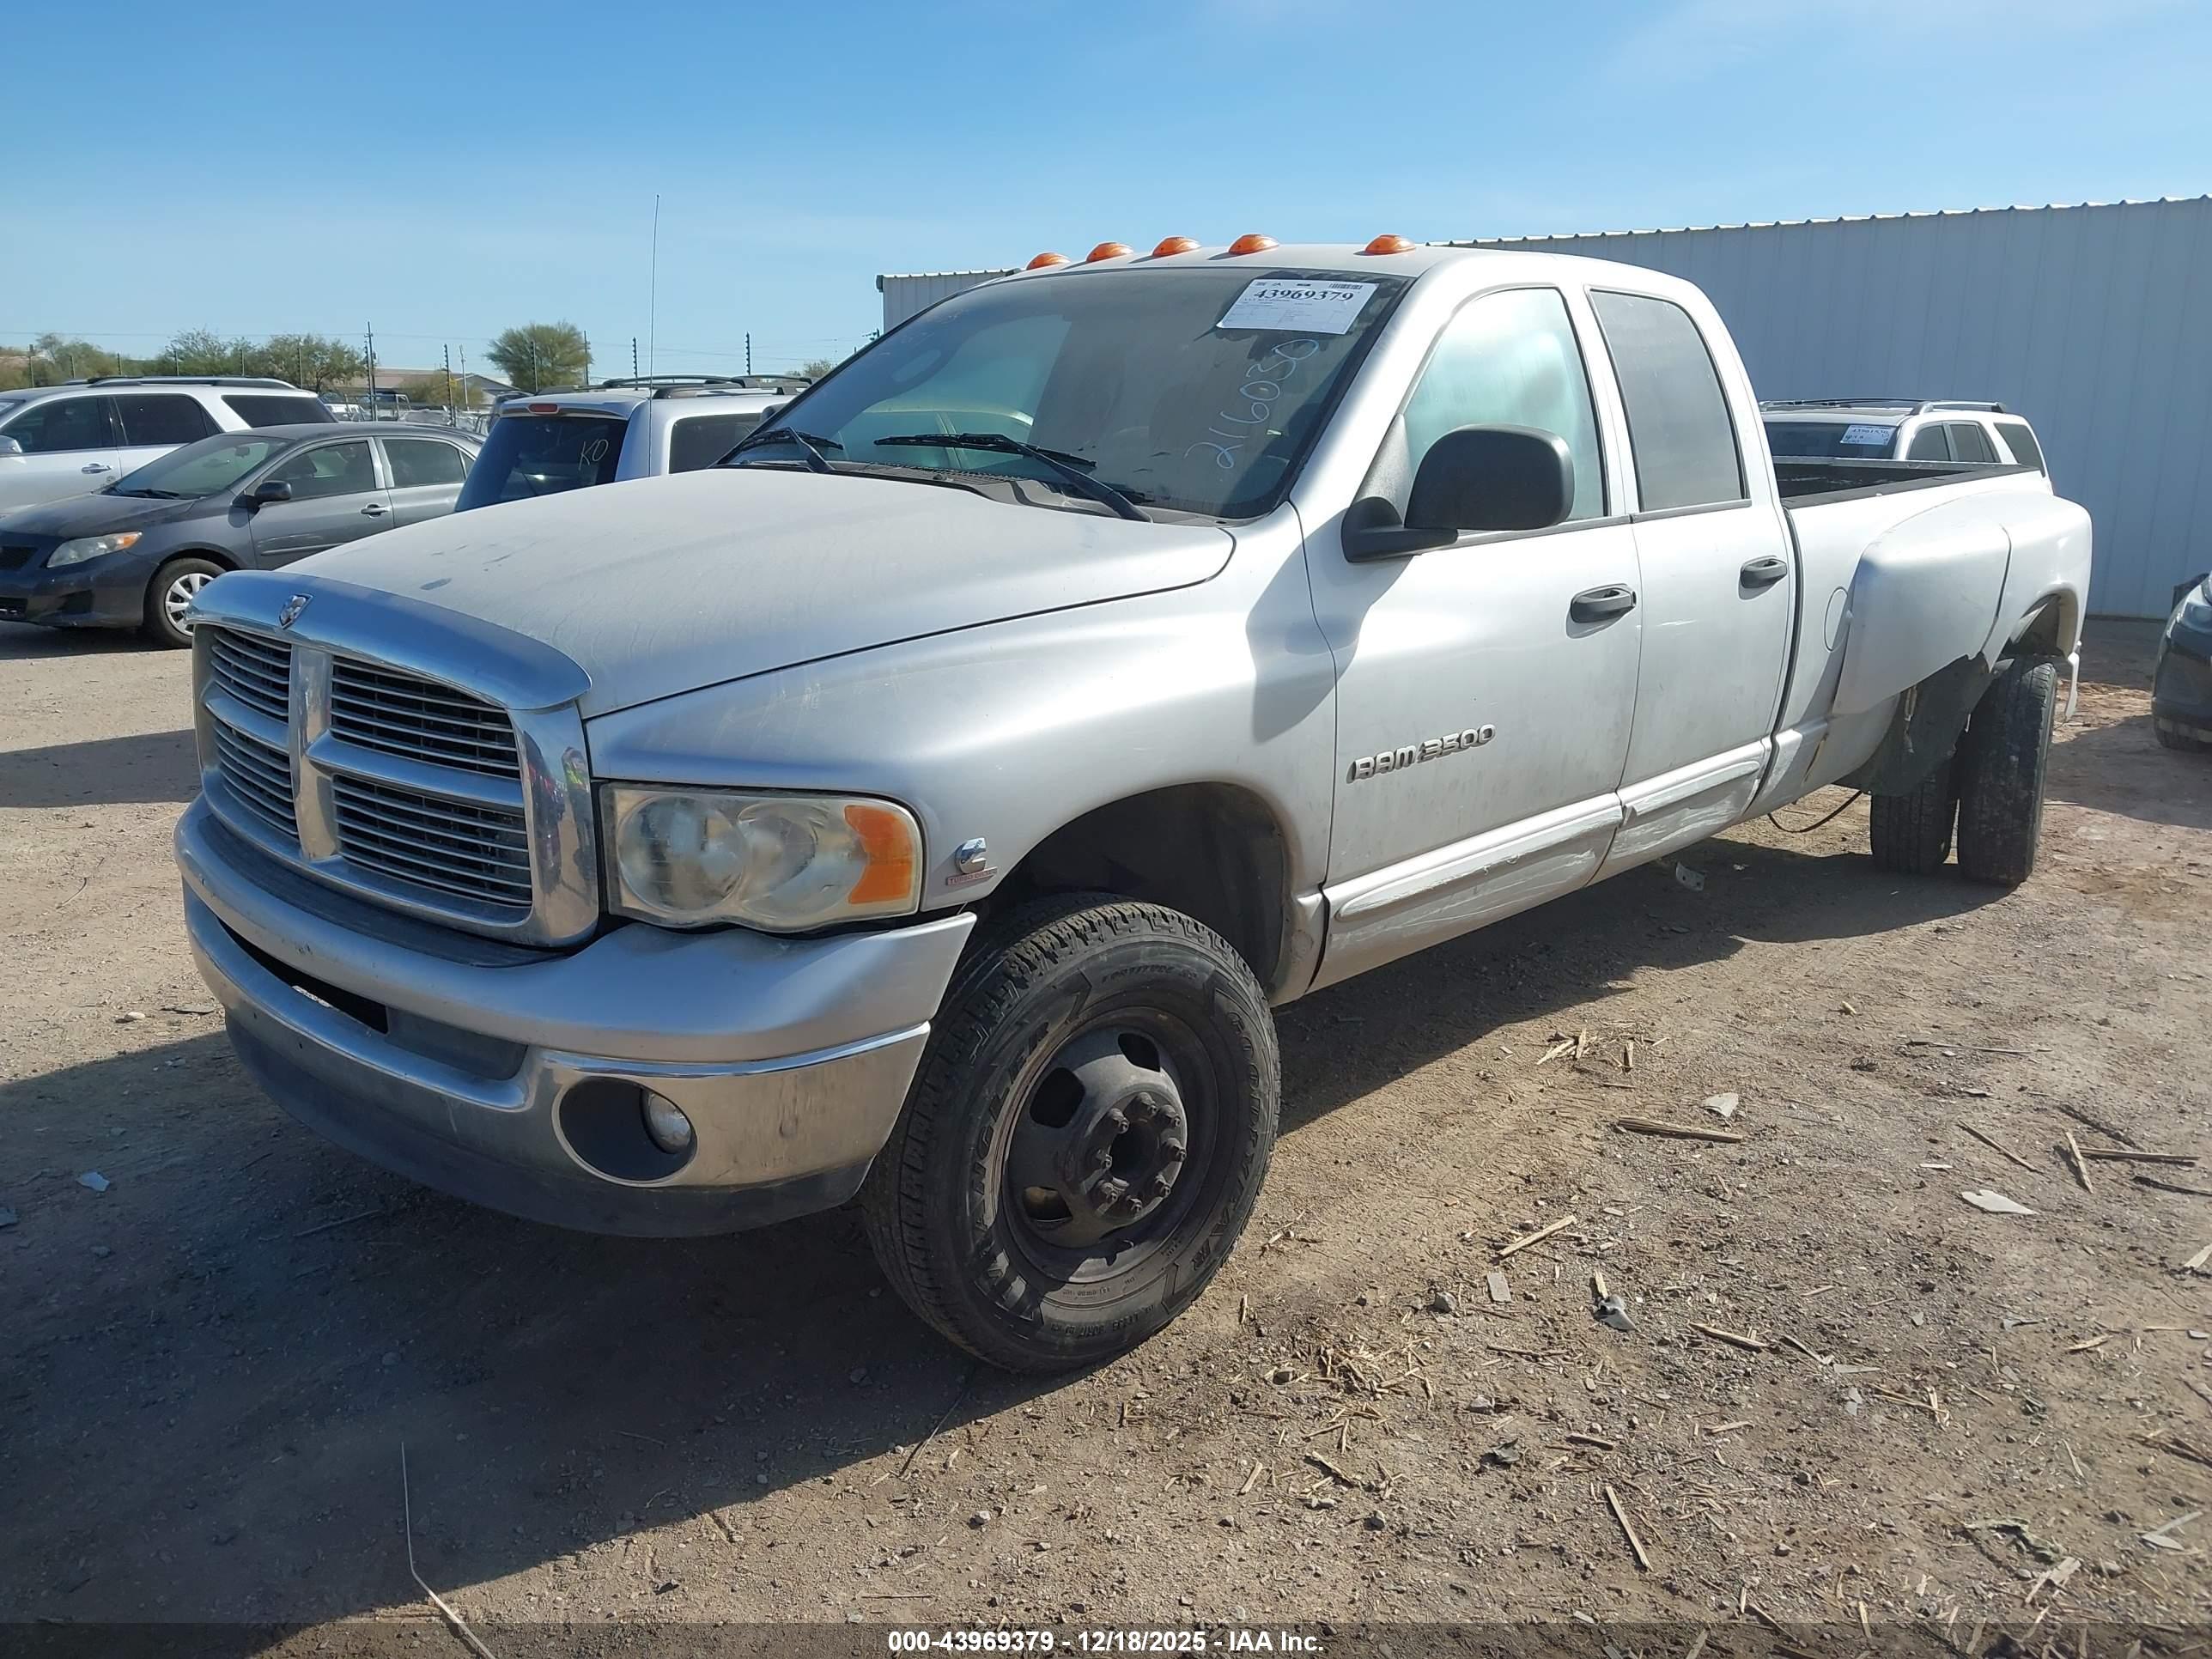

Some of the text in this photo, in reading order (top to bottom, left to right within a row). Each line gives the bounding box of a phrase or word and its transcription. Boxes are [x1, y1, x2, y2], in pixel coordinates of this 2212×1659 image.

[1254, 289, 1354, 301] 43969379
[1347, 724, 1496, 783] RAM 3500
